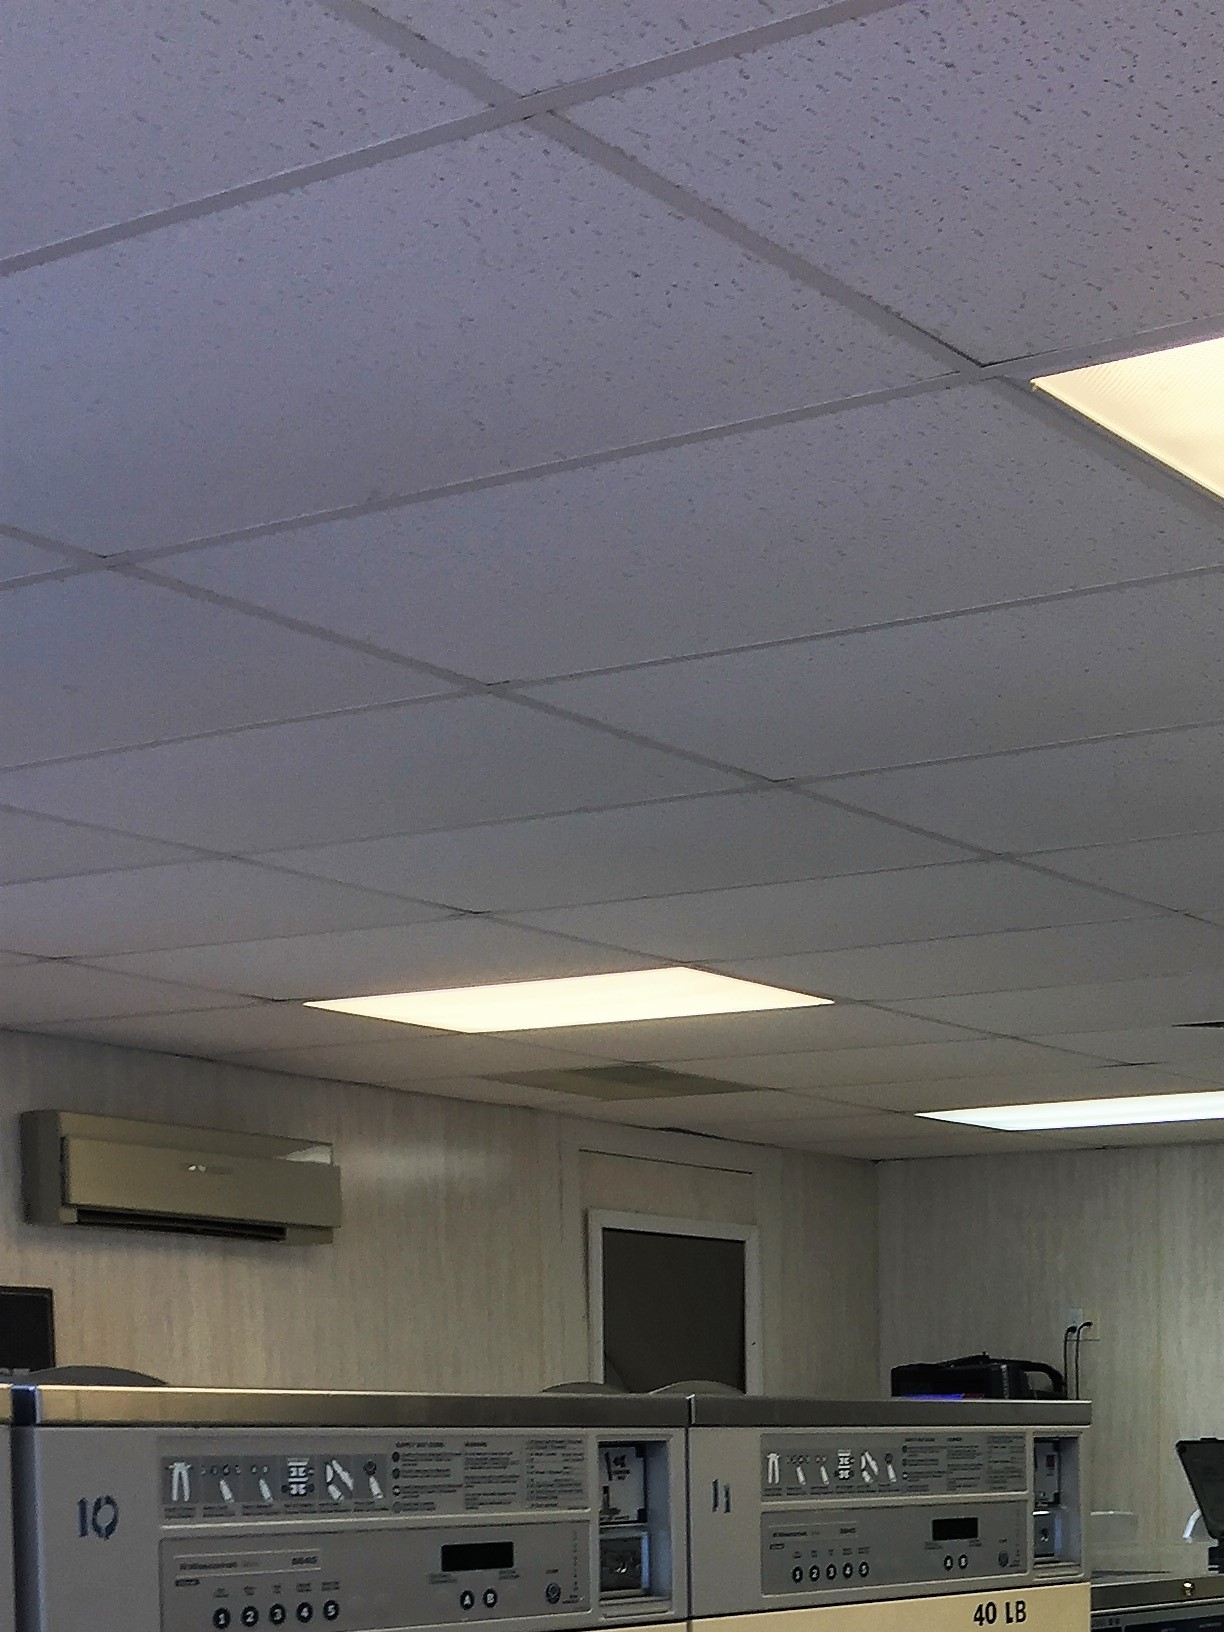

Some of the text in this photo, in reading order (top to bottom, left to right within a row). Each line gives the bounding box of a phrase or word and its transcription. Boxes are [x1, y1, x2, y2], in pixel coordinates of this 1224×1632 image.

[77, 1494, 119, 1540] 10
[973, 1598, 1027, 1625] 40 LB
